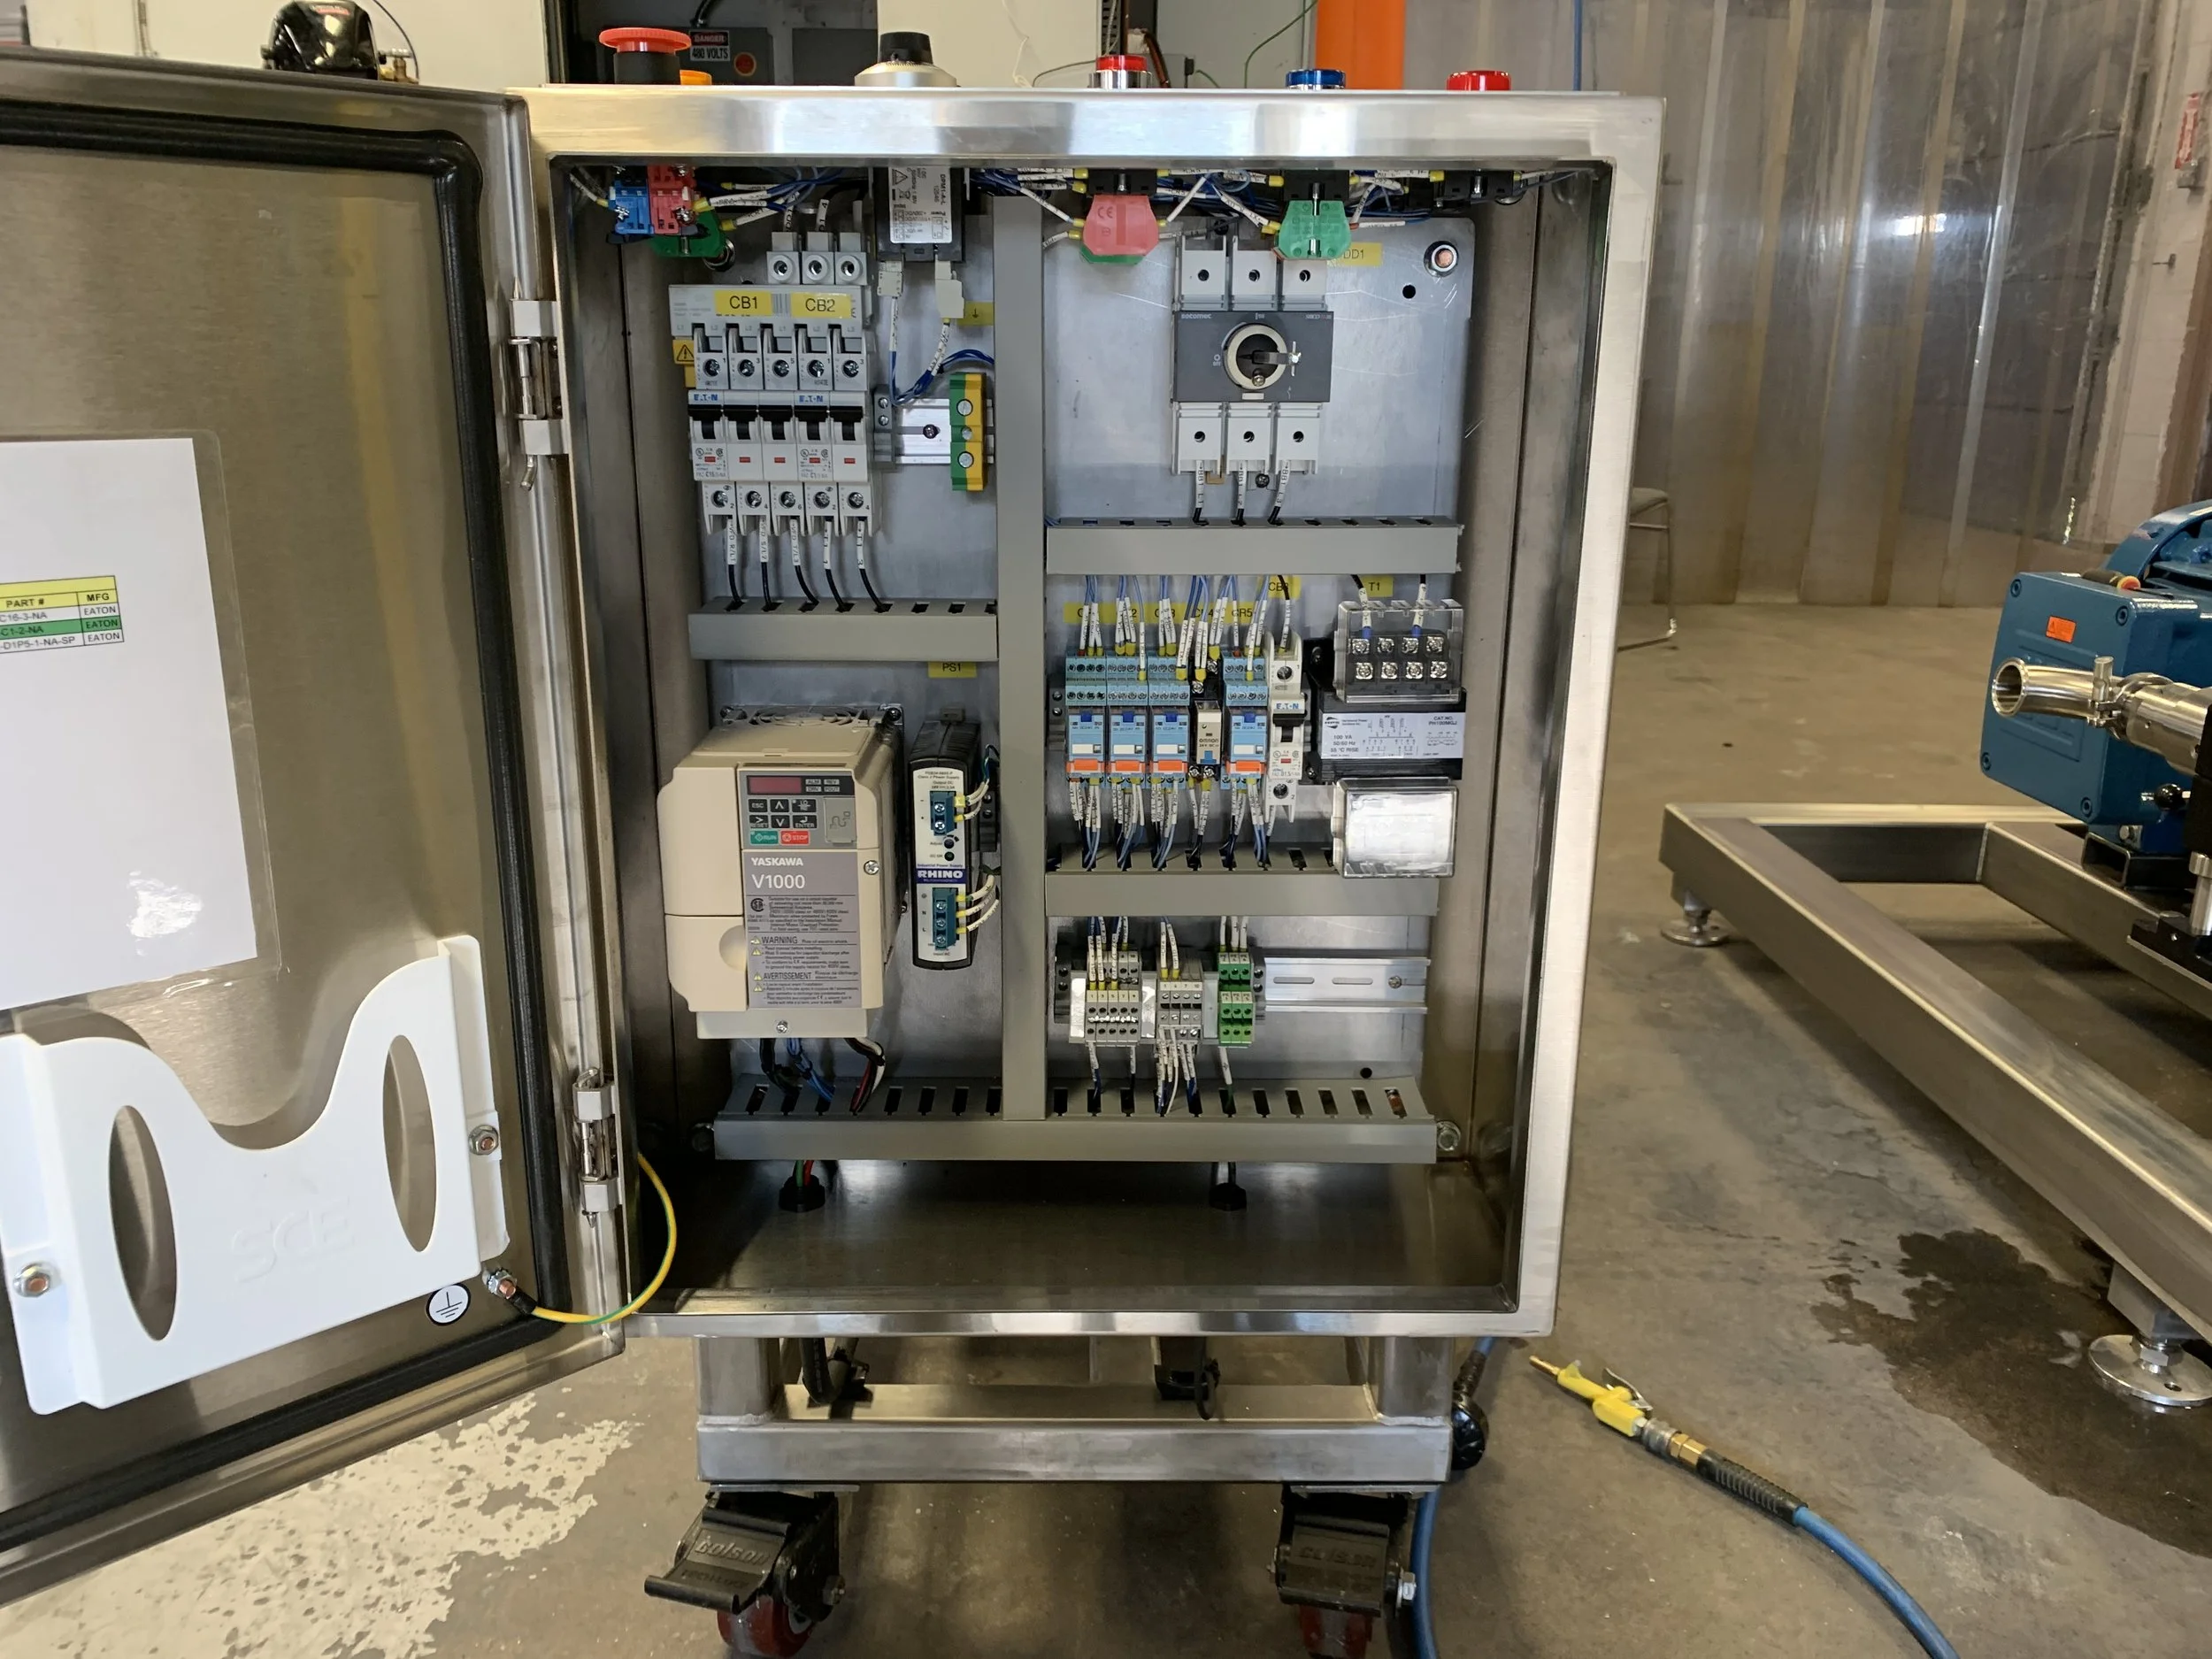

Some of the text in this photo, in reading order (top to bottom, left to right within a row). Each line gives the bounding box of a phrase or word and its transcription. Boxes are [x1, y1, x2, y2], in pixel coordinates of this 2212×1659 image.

[692, 48, 728, 58] 480 VOLTS
[729, 296, 757, 309] CB1
[805, 299, 835, 311] CB2
[1369, 582, 1379, 591] T1
[87, 593, 110, 602] MFG
[6, 599, 35, 608] PART
[84, 605, 116, 616] EATON
[86, 618, 118, 629] EATON
[88, 632, 120, 642] EATON
[942, 663, 961, 672] PS1
[751, 857, 803, 866] YASKAWA
[751, 874, 805, 889] V1000
[695, 1540, 770, 1565] Colson
